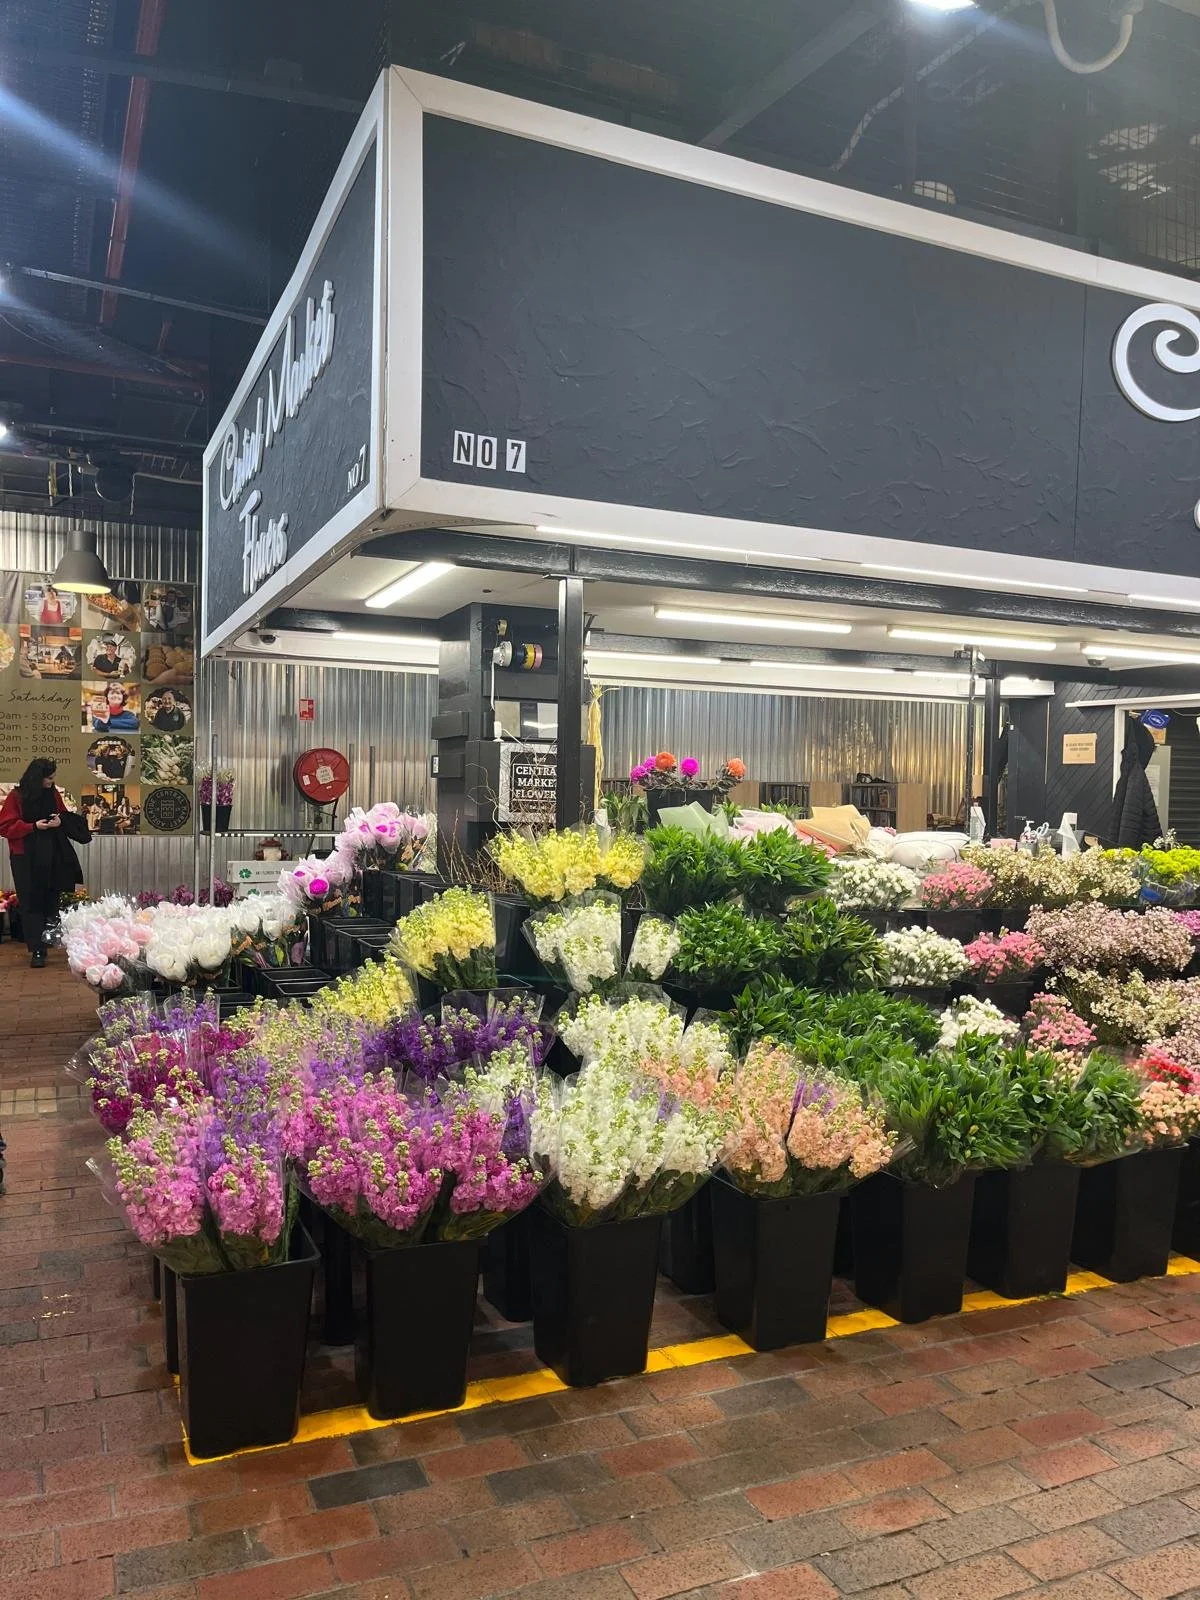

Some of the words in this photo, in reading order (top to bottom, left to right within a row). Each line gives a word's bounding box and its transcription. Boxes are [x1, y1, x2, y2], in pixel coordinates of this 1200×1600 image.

[265, 279, 336, 448] Market
[455, 432, 494, 467] NO
[359, 443, 366, 482] 7
[8, 689, 76, 710] Saturday
[32, 712, 70, 722] 5:30pm
[32, 734, 71, 743] 5:30pm
[32, 744, 71, 754] 9:00pm
[515, 765, 557, 776] CENTRA
[515, 789, 557, 799] FLOWER
